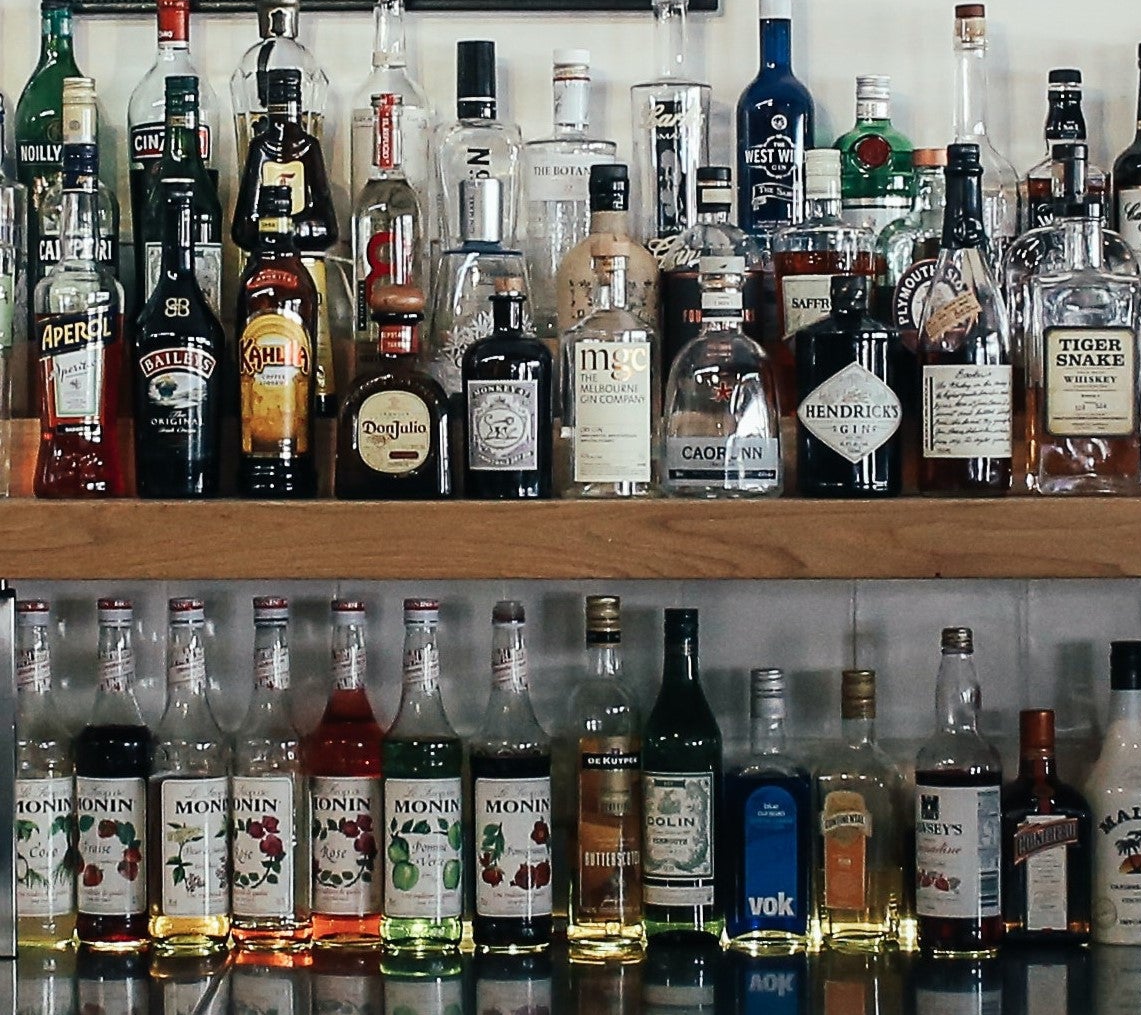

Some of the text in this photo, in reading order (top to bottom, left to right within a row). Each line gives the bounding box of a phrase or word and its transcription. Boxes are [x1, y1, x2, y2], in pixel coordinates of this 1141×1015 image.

[20, 144, 62, 162] NOILLY
[745, 149, 774, 164] WEST
[533, 165, 551, 177] THE
[41, 316, 112, 352] APEROL
[1058, 338, 1122, 352] TIGER
[143, 349, 214, 373] BAILEYS
[580, 347, 647, 382] mgc
[1055, 353, 1125, 368] SNAKE
[580, 373, 598, 383] THE
[1062, 374, 1118, 384] WHISKEY
[580, 384, 639, 394] MELBOURNE
[579, 394, 646, 404] GIN COMPANY
[805, 404, 899, 419] HENDRICK'S
[839, 424, 871, 435] GIN
[394, 799, 460, 814] MONIN
[485, 799, 551, 814] MONIN
[646, 816, 695, 828] DOLIN
[747, 891, 795, 917] vok
